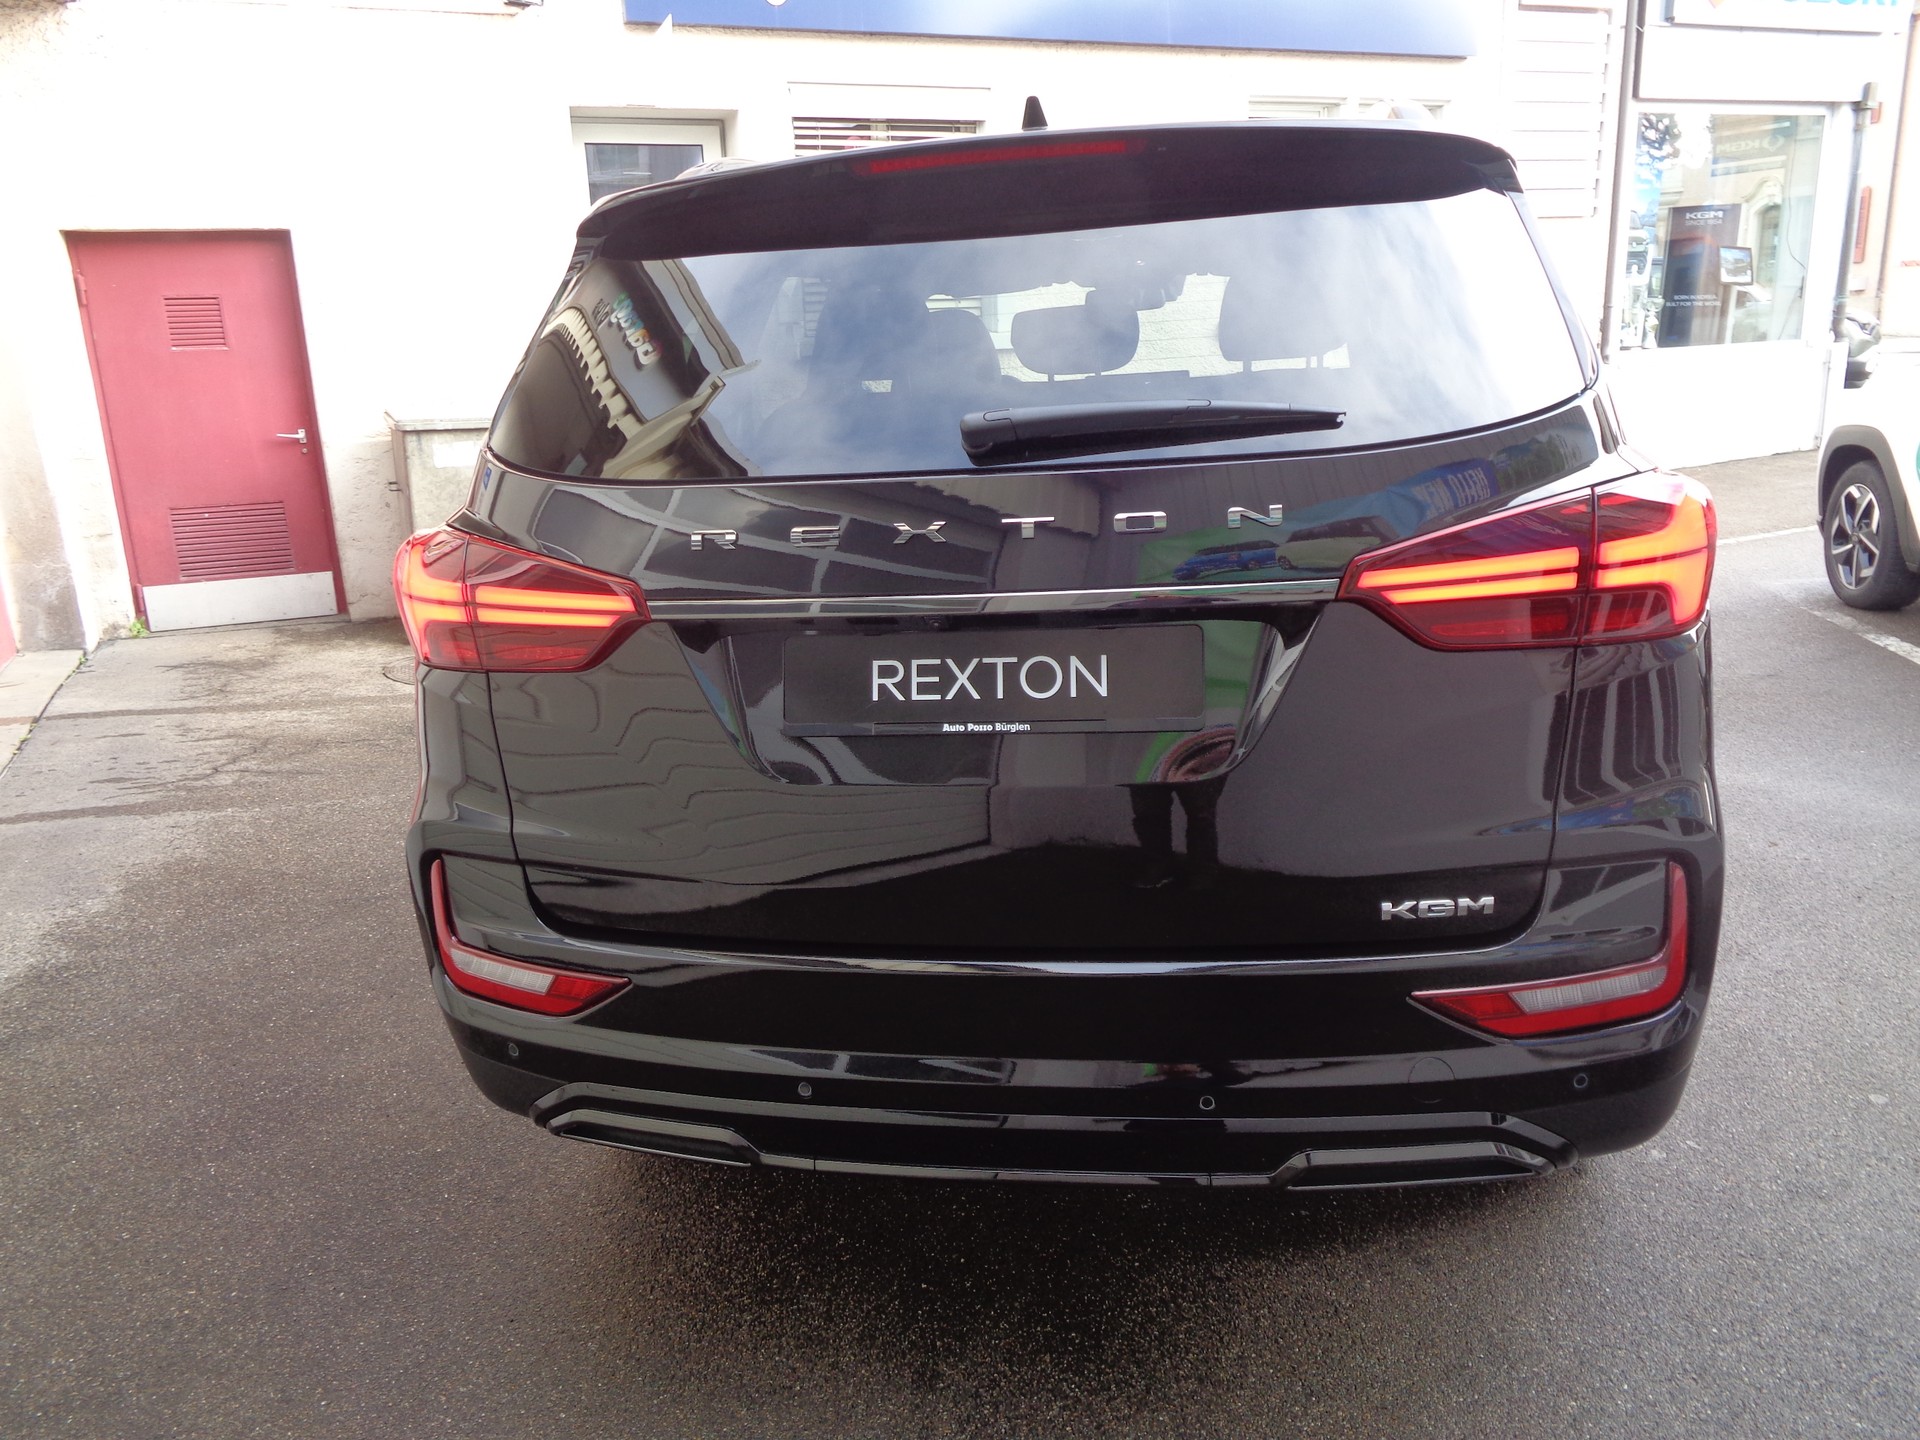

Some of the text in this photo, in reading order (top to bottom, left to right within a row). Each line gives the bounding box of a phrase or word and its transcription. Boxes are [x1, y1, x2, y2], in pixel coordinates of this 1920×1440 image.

[1685, 211, 1723, 219] KGM
[691, 504, 1283, 551] REXTON
[872, 654, 1108, 701] REXTON
[942, 723, 965, 732] Auto
[995, 722, 1031, 733] Bürglen
[1381, 896, 1495, 921] KGM
